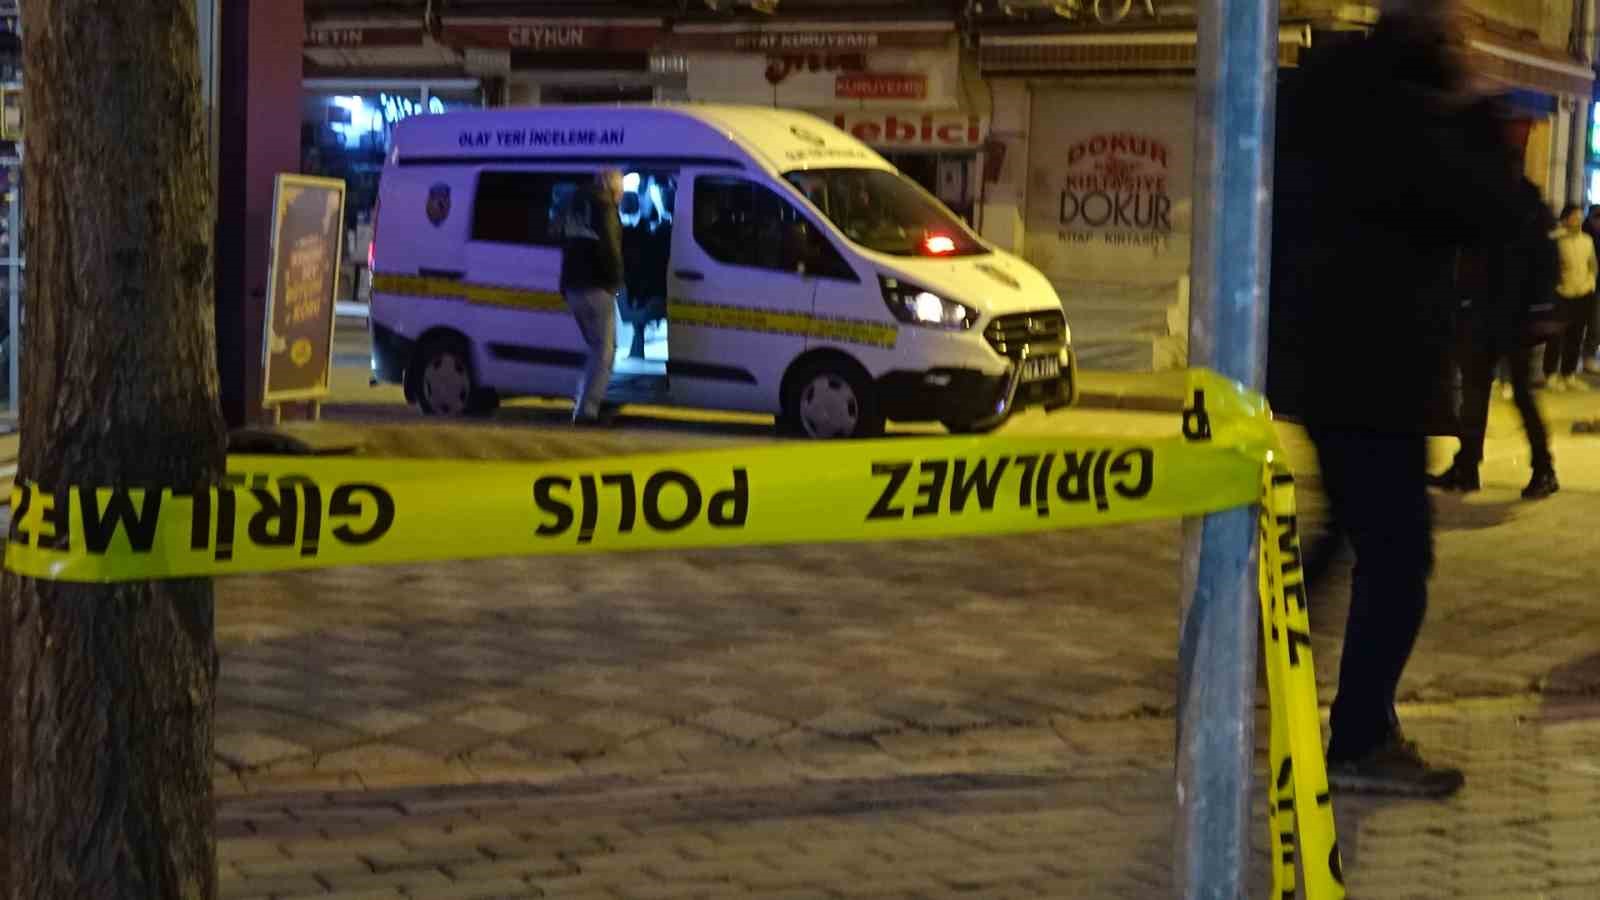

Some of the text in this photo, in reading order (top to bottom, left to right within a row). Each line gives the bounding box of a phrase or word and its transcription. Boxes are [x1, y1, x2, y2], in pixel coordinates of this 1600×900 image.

[508, 27, 585, 46] CEYHUN
[457, 130, 490, 148] OLAY
[496, 128, 527, 146] YERİ
[1067, 132, 1168, 168] DOKUR
[1059, 188, 1172, 231] DOKUR
[864, 445, 1154, 522] GİRİLMEZ
[534, 465, 750, 545] POLİS
